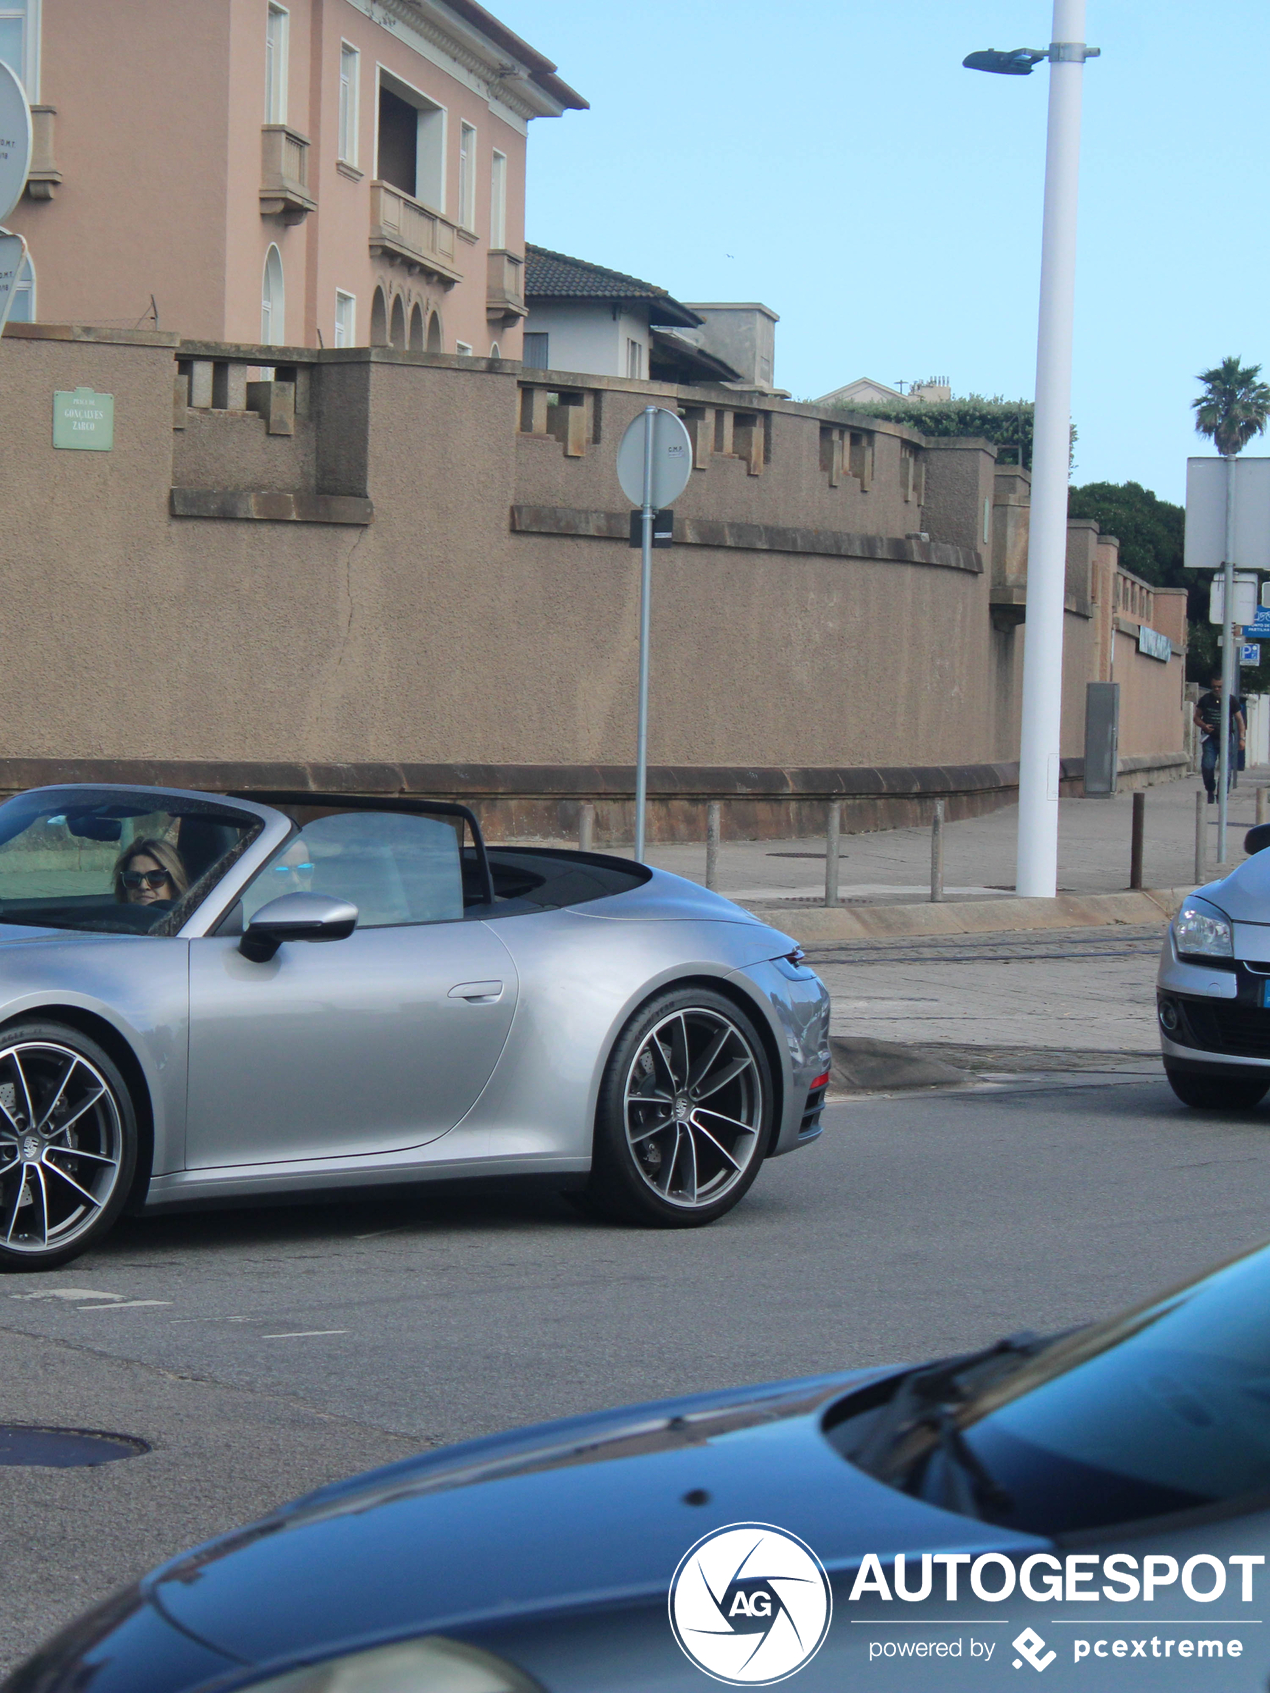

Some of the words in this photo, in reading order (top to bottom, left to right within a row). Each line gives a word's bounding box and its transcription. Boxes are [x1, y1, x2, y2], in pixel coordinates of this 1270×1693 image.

[64, 408, 104, 420] GONÇALVES
[72, 421, 95, 431] ZARCO
[1242, 645, 1251, 659] P
